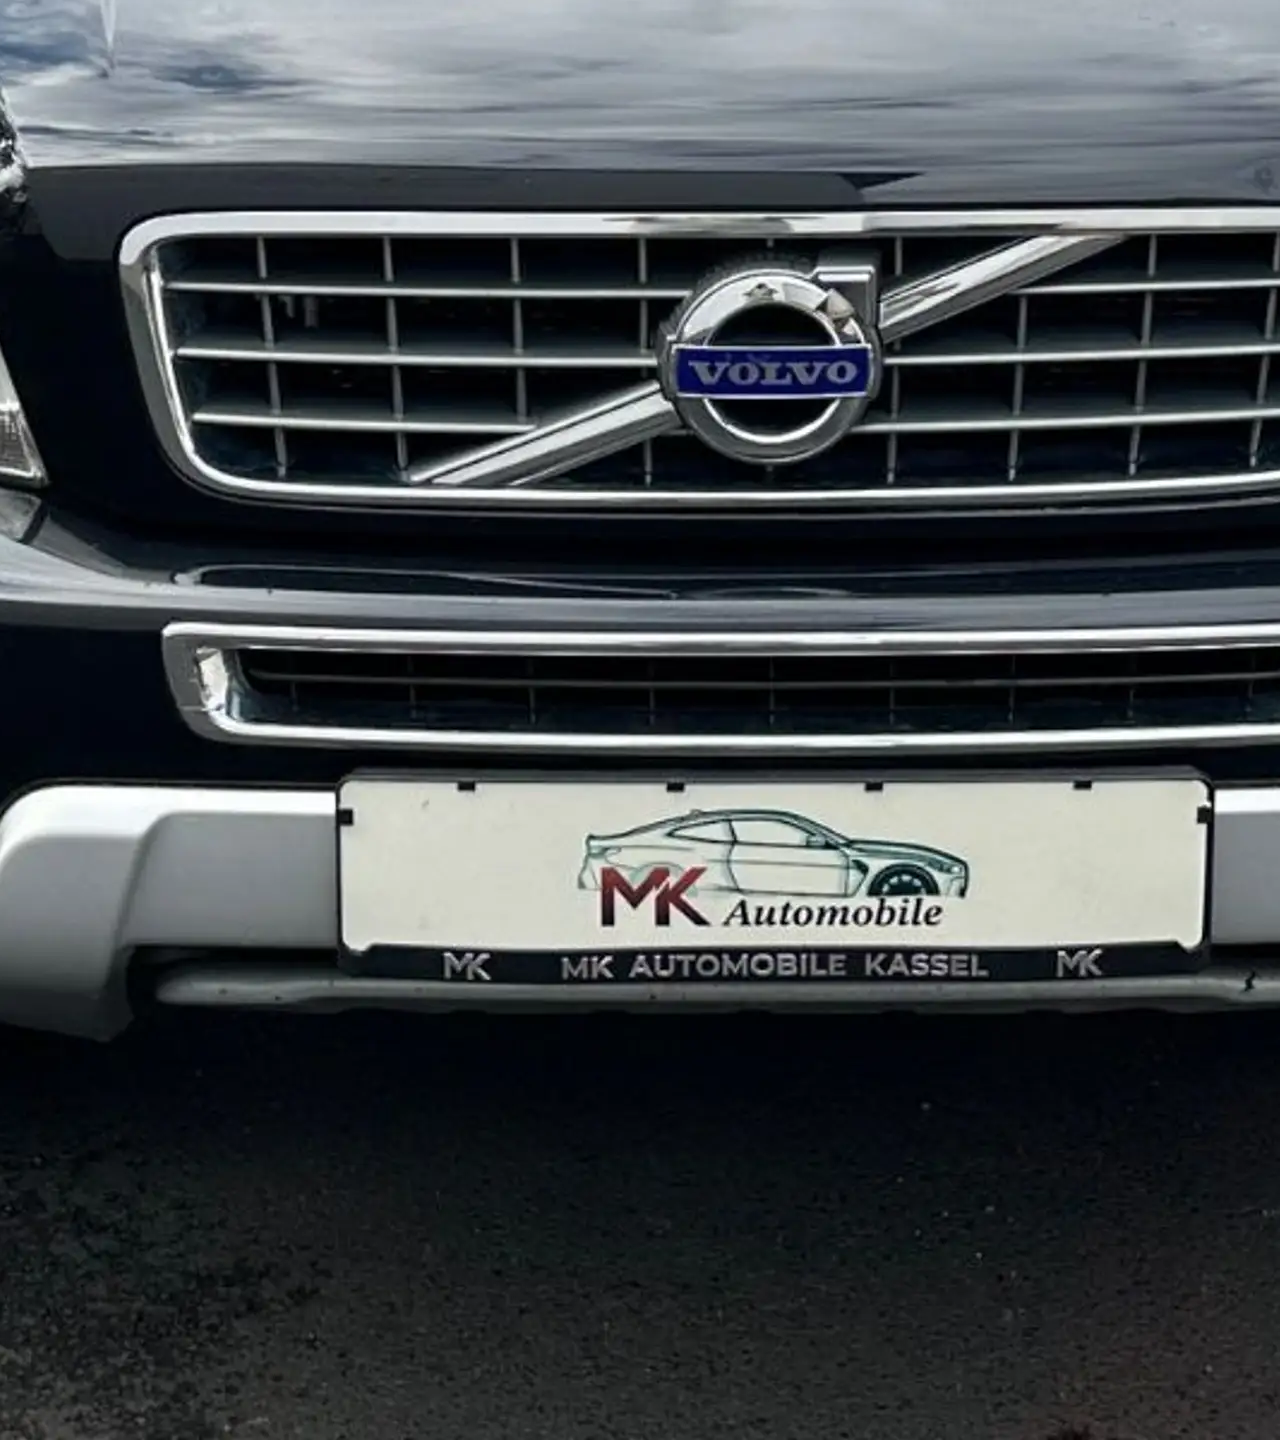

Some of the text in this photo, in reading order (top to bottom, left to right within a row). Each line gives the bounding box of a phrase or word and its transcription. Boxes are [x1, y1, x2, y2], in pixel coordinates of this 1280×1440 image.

[688, 360, 858, 386] VOLVO
[601, 866, 712, 927] MK
[723, 898, 943, 927] Automobile
[443, 949, 1103, 981] MK MK AUTOMOBILE KASSEL MK
